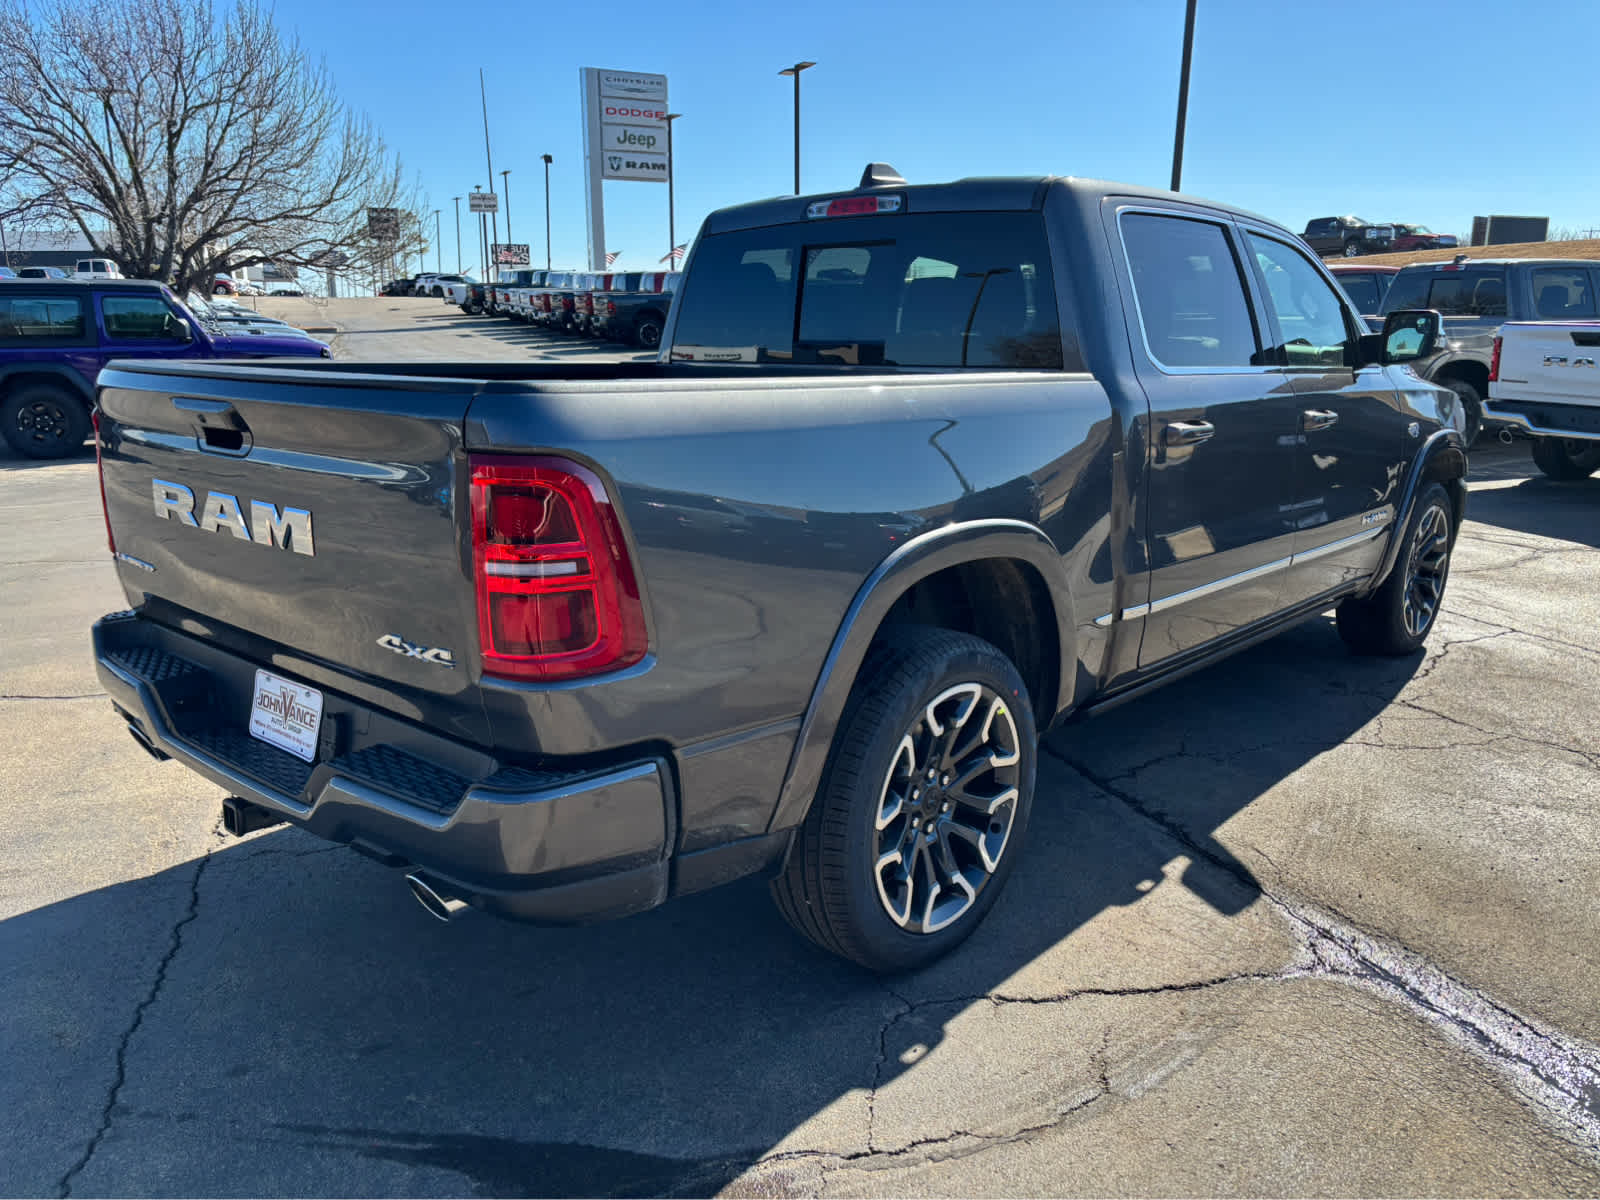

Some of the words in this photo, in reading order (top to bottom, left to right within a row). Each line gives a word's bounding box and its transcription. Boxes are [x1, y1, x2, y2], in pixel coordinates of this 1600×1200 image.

[605, 107, 666, 120] DODGE
[616, 129, 656, 149] Jeep
[625, 160, 666, 171] RAM
[152, 478, 315, 557] RAM
[257, 693, 283, 714] JOHN
